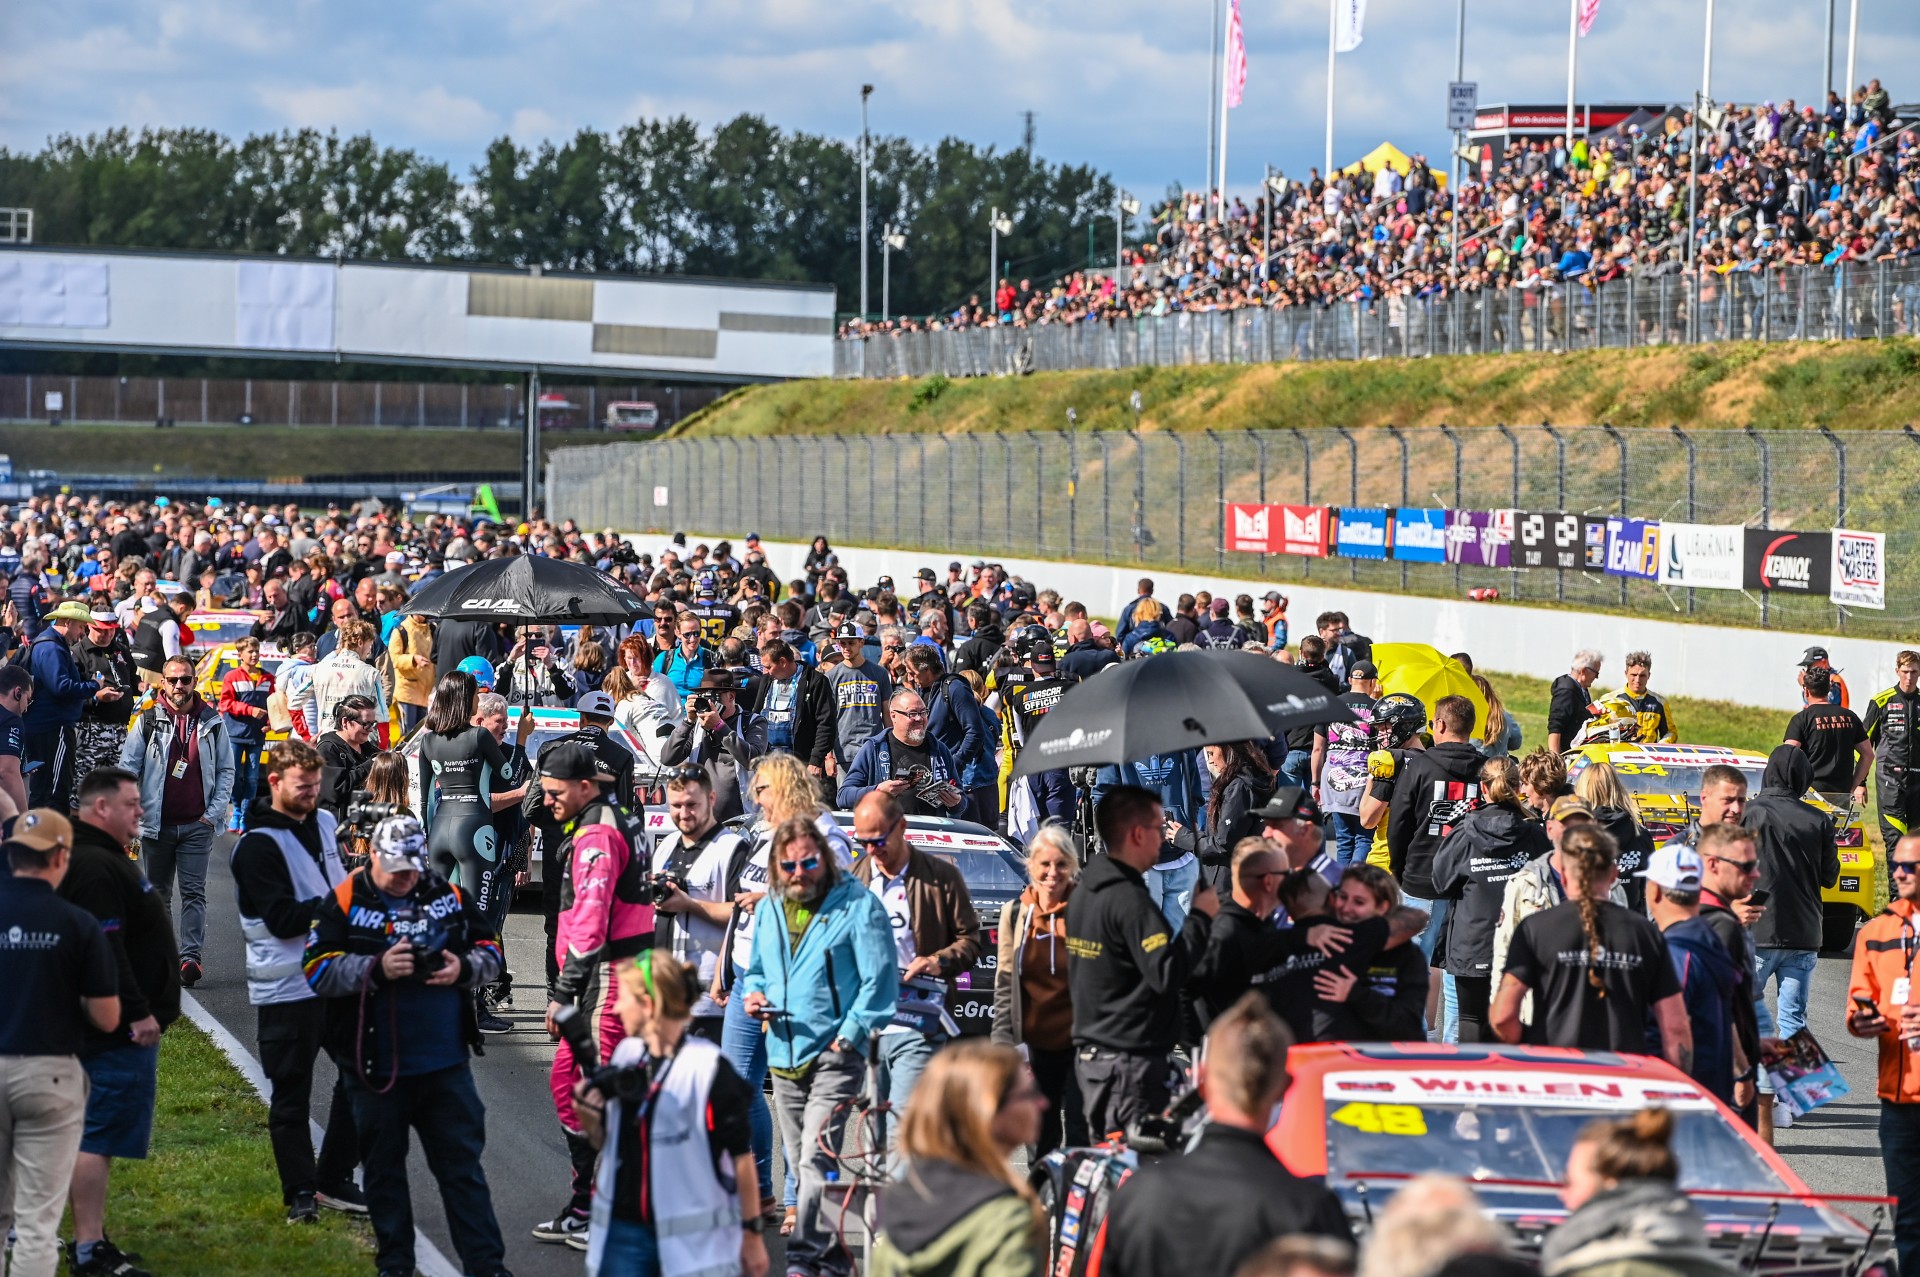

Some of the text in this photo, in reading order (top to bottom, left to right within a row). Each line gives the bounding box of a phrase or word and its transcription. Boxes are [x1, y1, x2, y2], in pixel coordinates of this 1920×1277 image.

[1686, 534, 1736, 557] LIBURNIA
[1764, 555, 1811, 580] KENNOL
[838, 684, 867, 695] CHASE
[1031, 686, 1062, 700] NASCAR
[838, 693, 878, 706] ELLIOTT
[1815, 715, 1852, 724] EVENT
[444, 758, 478, 769] Avangarde
[1649, 755, 1740, 765] WHELEN
[445, 766, 465, 774] Group
[1614, 763, 1669, 776] 34
[648, 815, 664, 827] 14
[1841, 853, 1859, 863] 34
[477, 870, 492, 911] Group
[1410, 1076, 1623, 1098] WHELEN
[1332, 1102, 1429, 1137] 48
